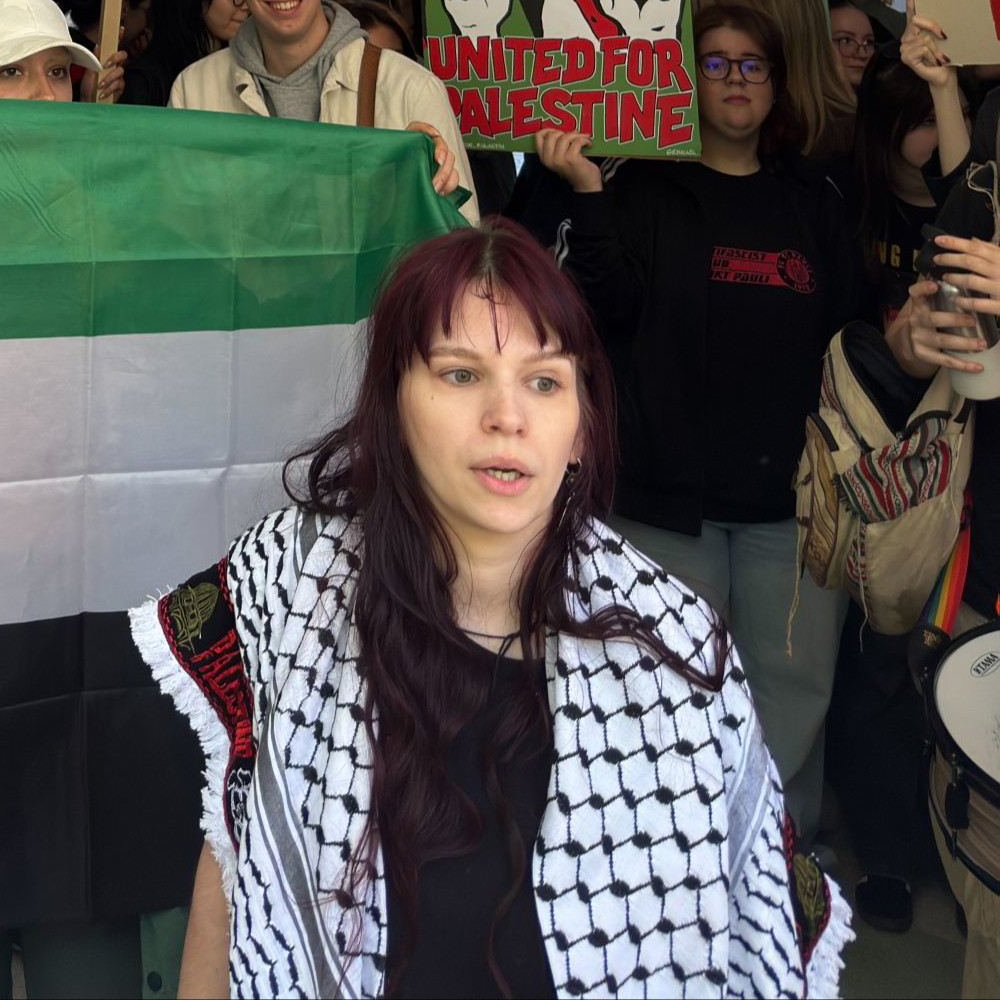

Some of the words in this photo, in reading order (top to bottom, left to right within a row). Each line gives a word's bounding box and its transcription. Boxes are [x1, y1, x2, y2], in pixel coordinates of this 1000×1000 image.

[427, 35, 597, 86] UNITED
[599, 36, 694, 91] FOR
[973, 653, 999, 675] TAMA
